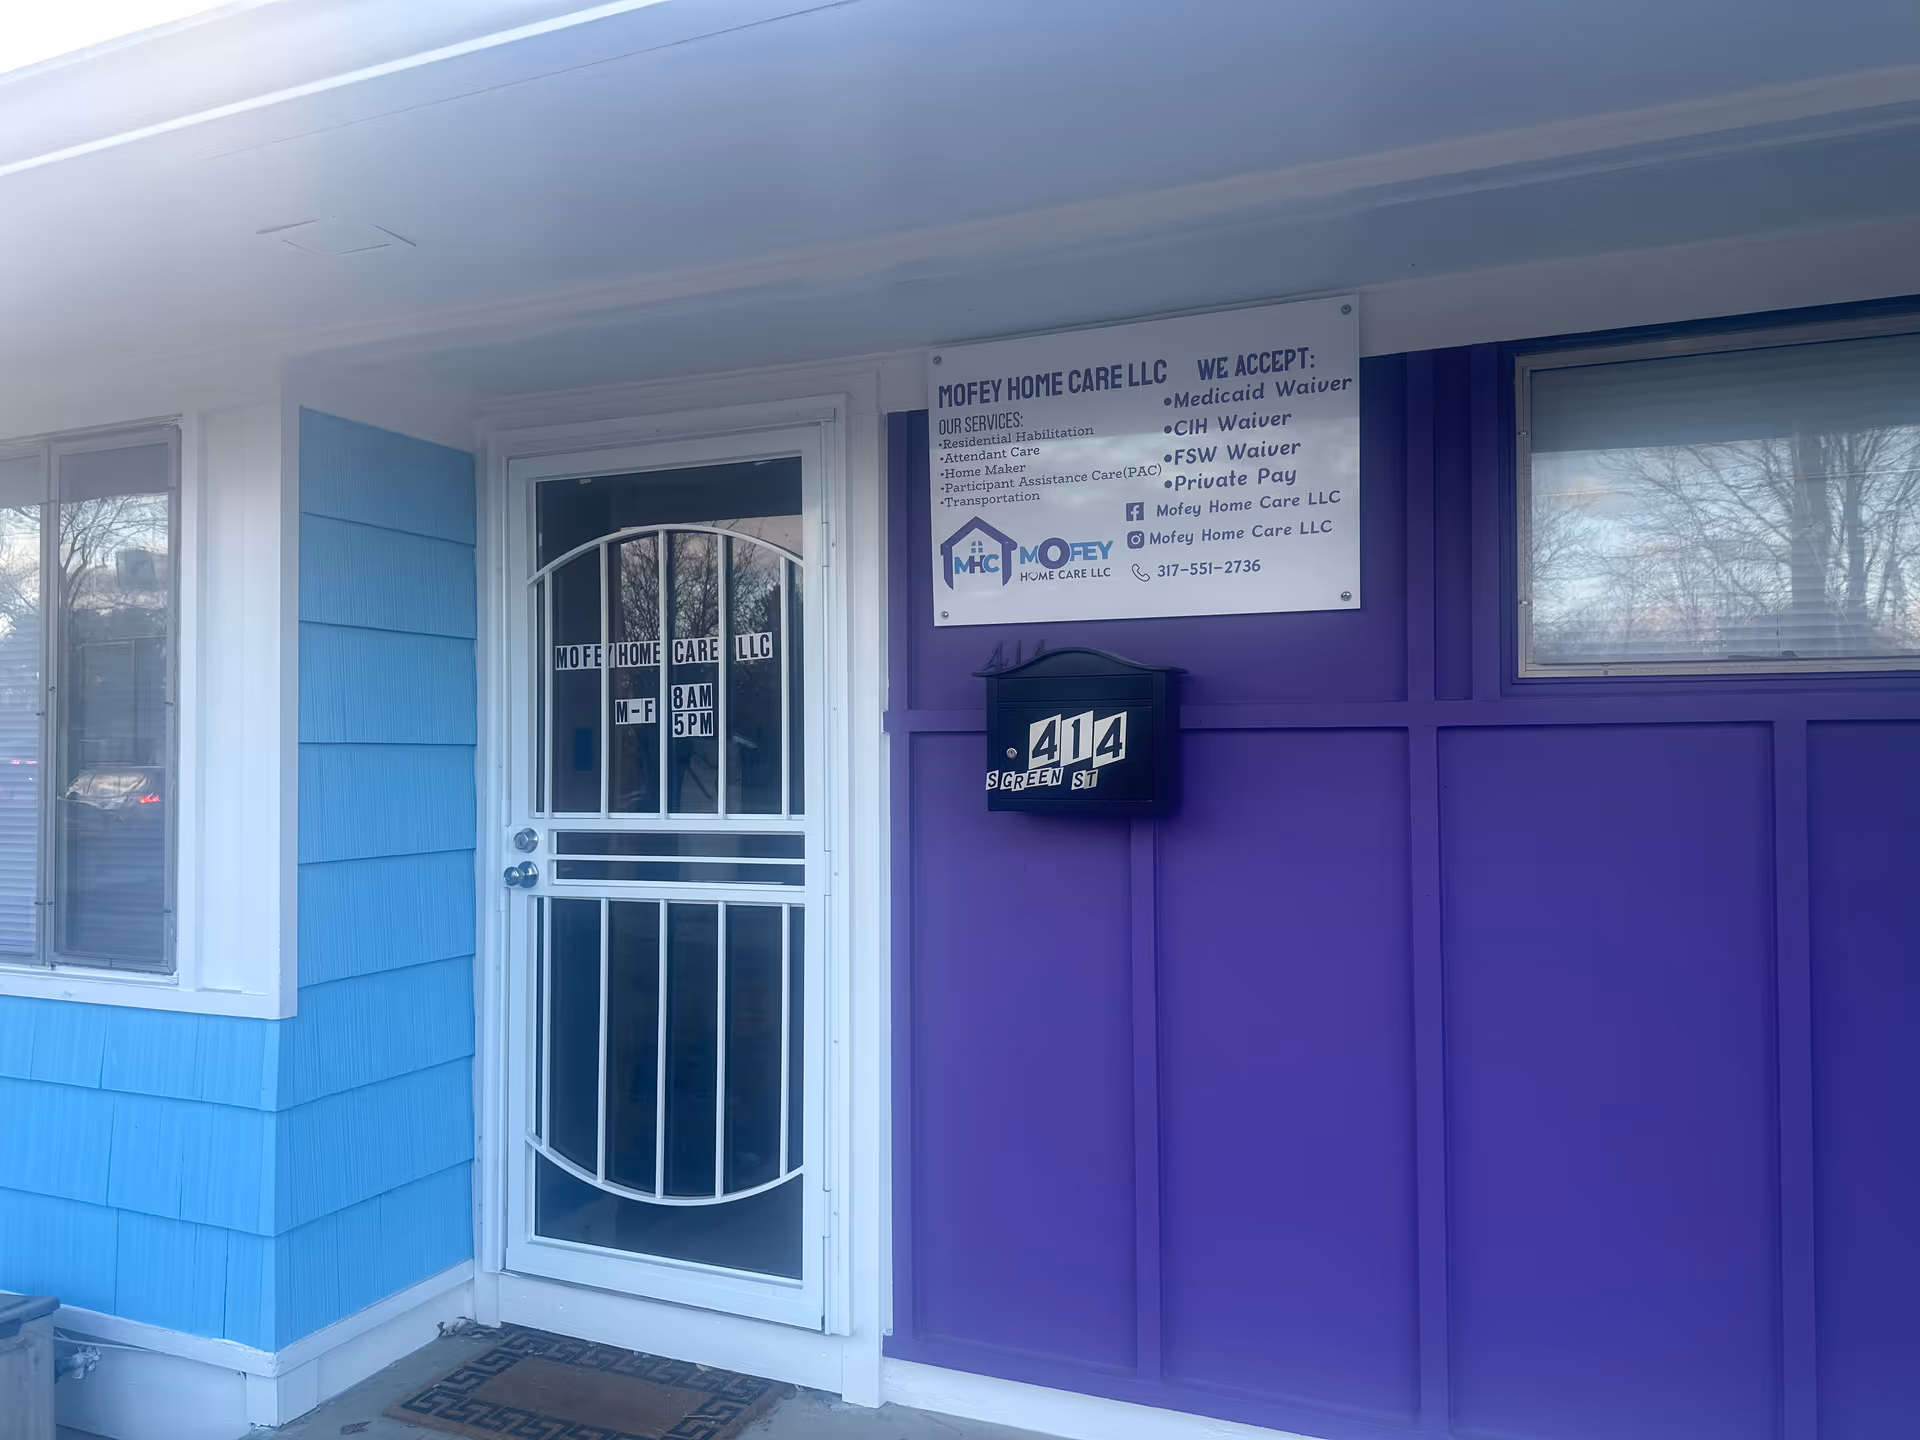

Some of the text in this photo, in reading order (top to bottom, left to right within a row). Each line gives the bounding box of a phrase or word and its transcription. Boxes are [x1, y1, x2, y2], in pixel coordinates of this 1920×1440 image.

[1197, 347, 1315, 381] WE ACCEPT:
[938, 359, 1168, 408] MOFEY HOME CARE LLC
[1173, 376, 1353, 408] Medicaid Waiver
[938, 411, 1024, 436] OUR SERVICES:
[1173, 412, 1292, 436] CIH Waiver
[942, 425, 1095, 450] Residential Habilitation
[944, 446, 1041, 464] Attendant Care
[1174, 440, 1302, 465] FSW Waiver
[944, 463, 1026, 479] Home Maker
[944, 463, 1162, 493] Participant Assistance Care(PAC)
[1174, 468, 1297, 491] Private Pay
[944, 491, 1041, 507] Transportation
[1156, 502, 1202, 518] Mofey
[1209, 499, 1252, 513] Home
[1259, 495, 1300, 509] Care
[1308, 490, 1341, 506] LLC
[1149, 520, 1333, 546] Mofey Home Care LLC
[954, 553, 1000, 575] MHC
[1019, 537, 1114, 570] MOFEY
[1020, 567, 1111, 582] HOME CARE LLC
[1157, 559, 1261, 578] 317-551-2736
[618, 642, 661, 666] HOME
[674, 638, 719, 664] CARE
[738, 633, 770, 659] LLC
[673, 685, 712, 709] 8AM
[616, 700, 653, 723] M-F
[674, 712, 713, 736] 5PM
[1031, 716, 1123, 761] 414
[1073, 770, 1097, 788] ST
